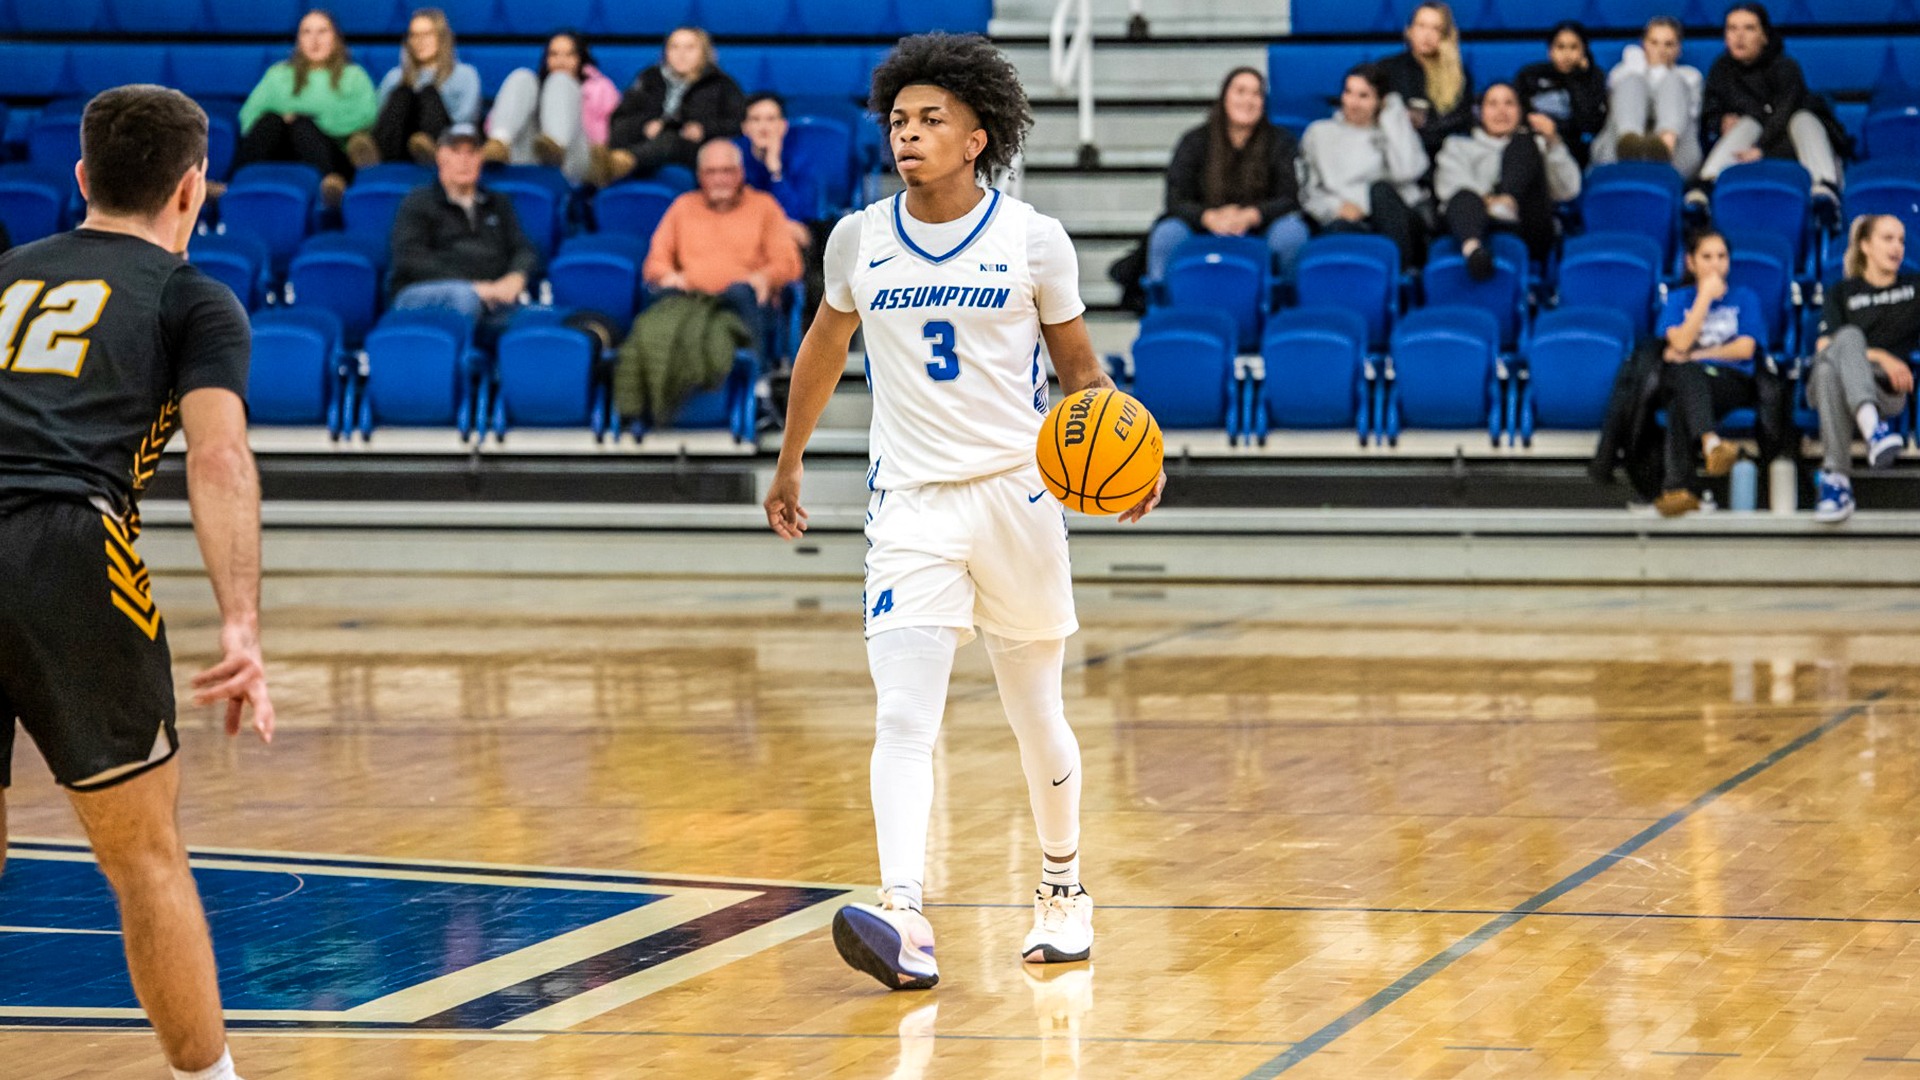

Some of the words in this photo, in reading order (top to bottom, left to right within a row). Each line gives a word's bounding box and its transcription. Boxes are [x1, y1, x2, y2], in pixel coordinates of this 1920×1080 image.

[870, 286, 1011, 310] ASSUMPTION
[0, 279, 112, 378] 12
[921, 319, 962, 383] 3
[1064, 388, 1099, 448] Wilso
[872, 588, 894, 617] A
